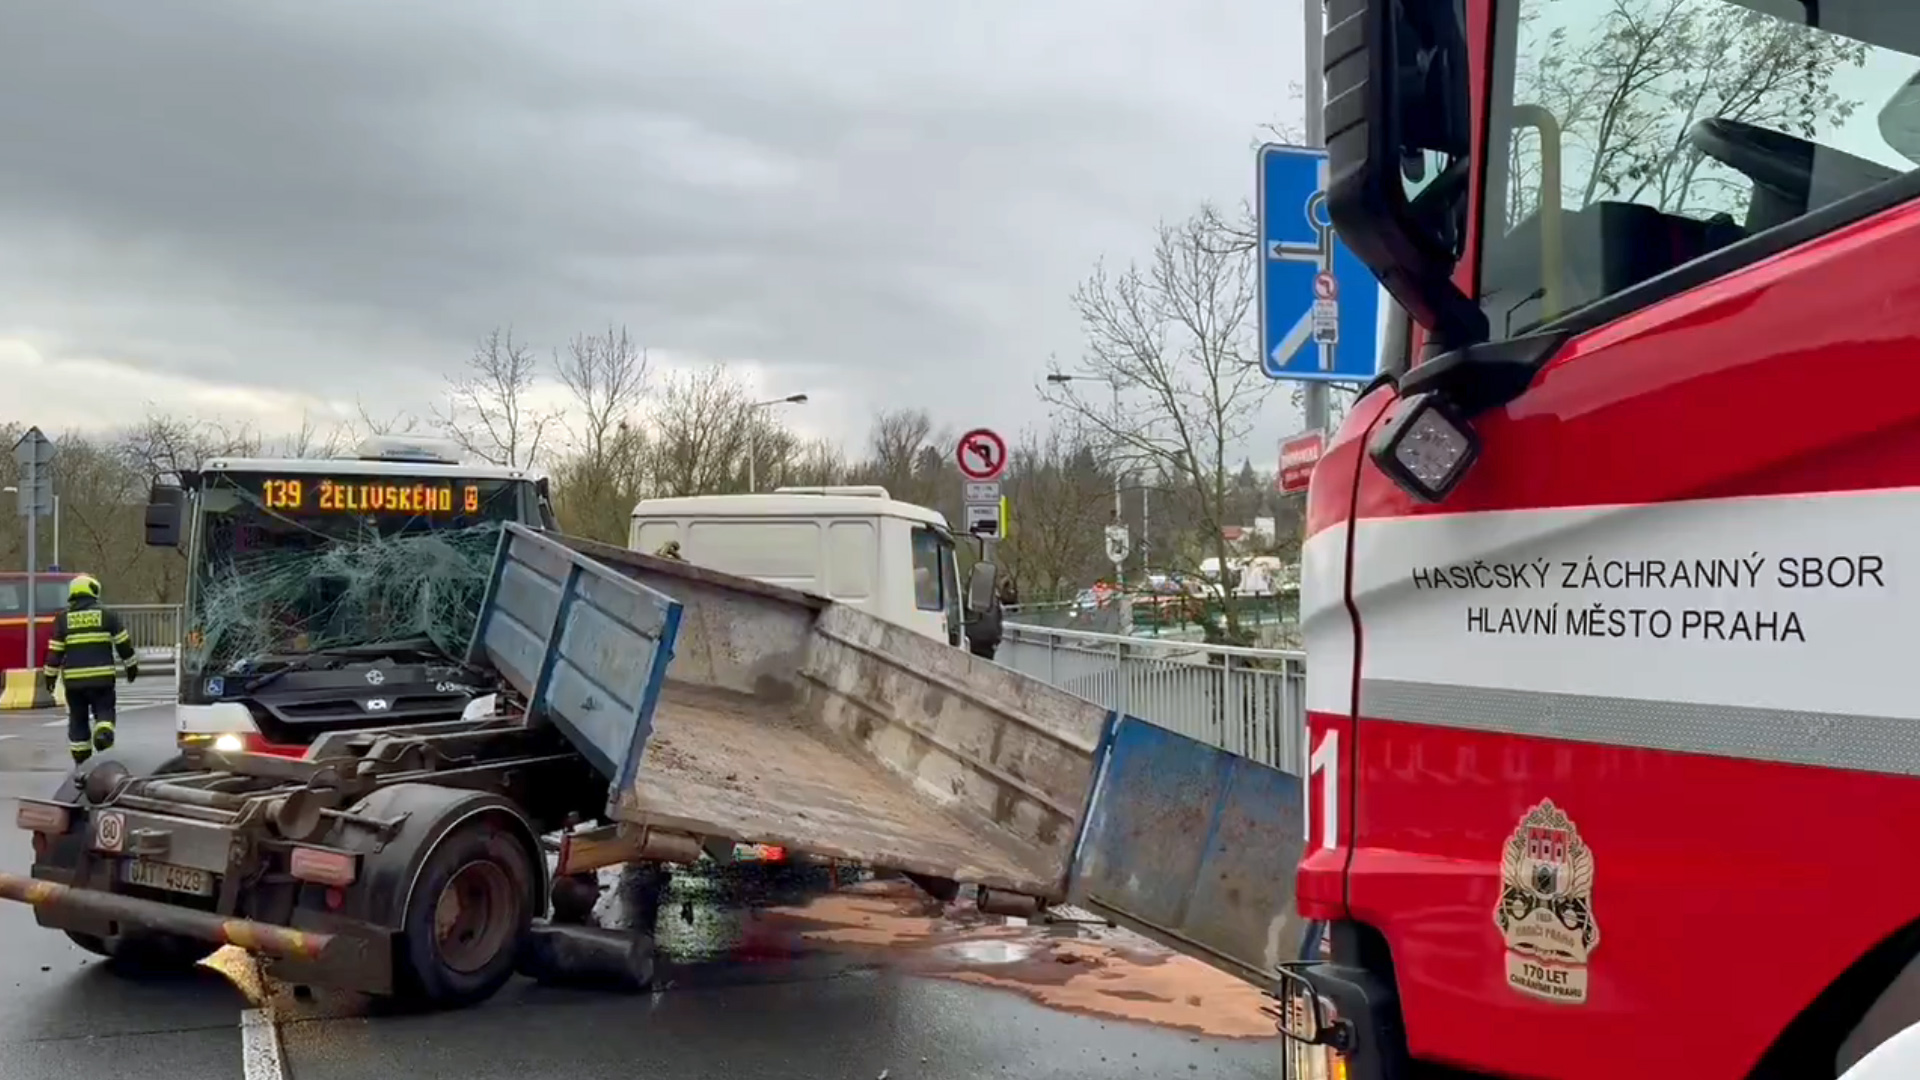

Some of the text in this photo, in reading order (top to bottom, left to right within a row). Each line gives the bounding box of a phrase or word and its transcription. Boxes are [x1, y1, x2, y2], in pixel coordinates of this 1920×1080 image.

[262, 479, 451, 511] 139 ŽELIVSKÉHO
[1412, 552, 1886, 589] HASIČSKÝ ZÁCHRANNÝ SBOR
[1467, 602, 1806, 643] HLAVNÍ MĚSTO PRAHA
[102, 819, 118, 840] 80
[1522, 963, 1569, 985] 170 LET
